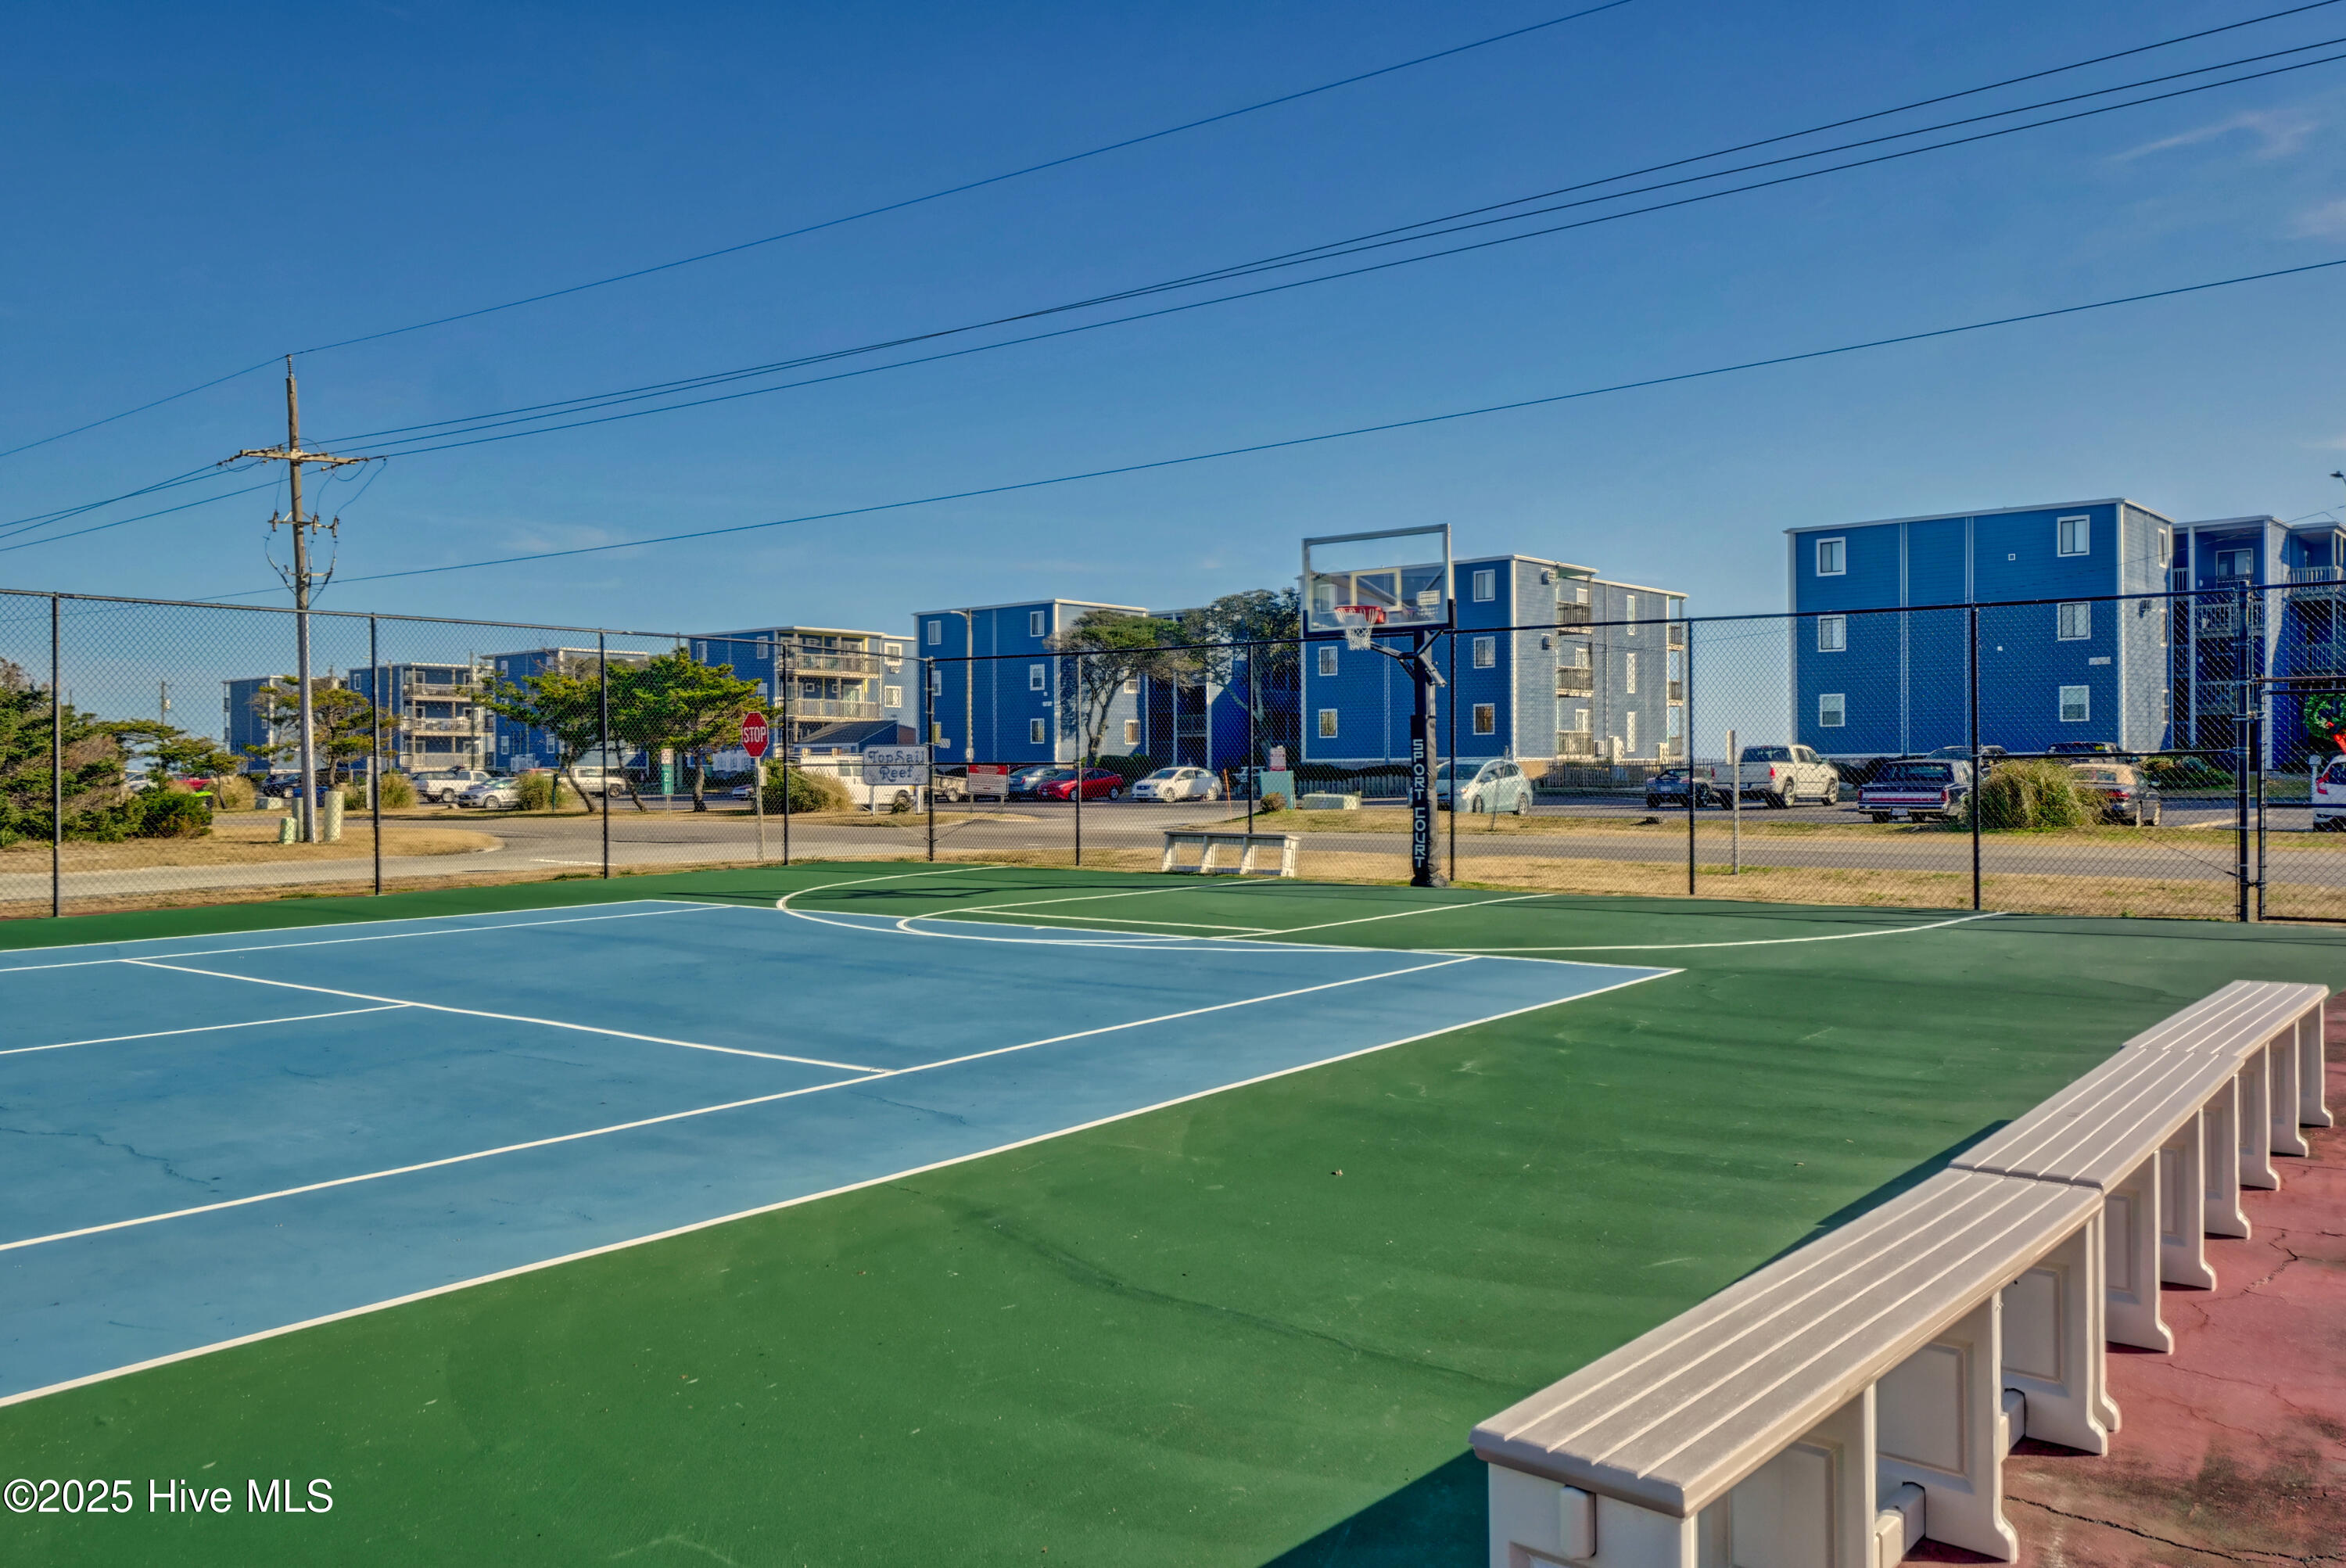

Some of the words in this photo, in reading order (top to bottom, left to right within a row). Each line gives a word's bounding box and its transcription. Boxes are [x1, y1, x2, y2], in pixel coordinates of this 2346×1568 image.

[743, 726, 767, 743] STOP
[879, 766, 914, 782] Reef
[1412, 738, 1426, 801] SPORT
[1414, 806, 1426, 868] COURT
